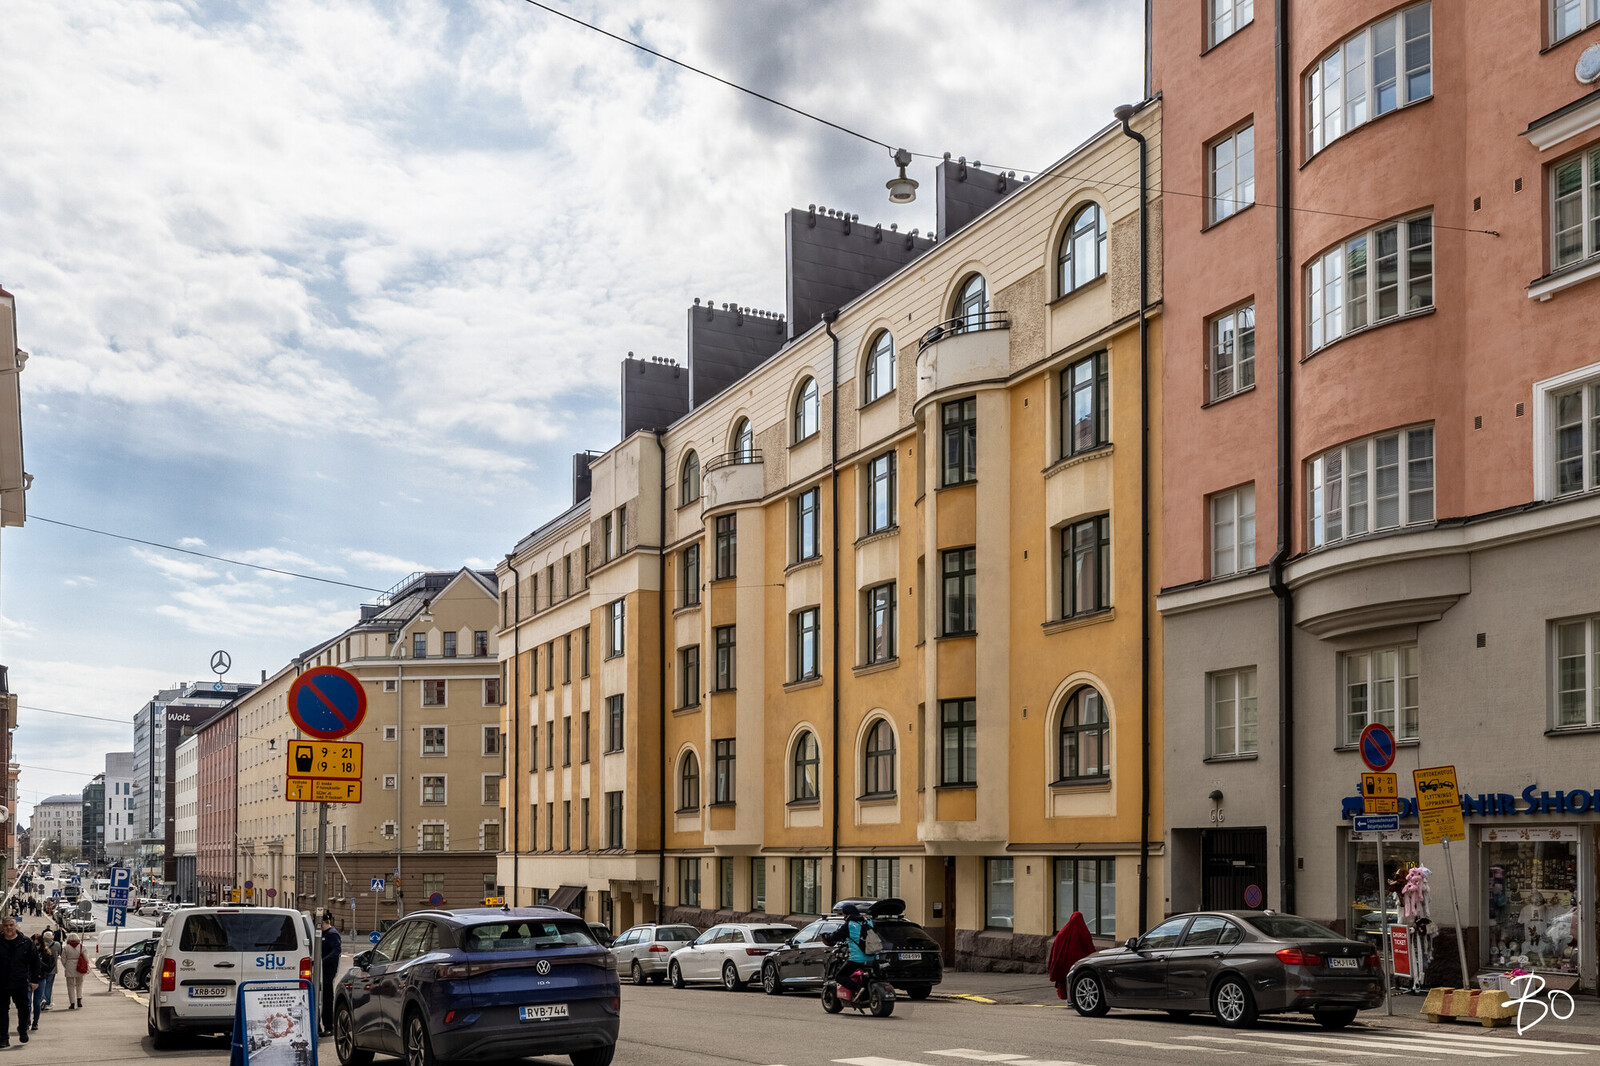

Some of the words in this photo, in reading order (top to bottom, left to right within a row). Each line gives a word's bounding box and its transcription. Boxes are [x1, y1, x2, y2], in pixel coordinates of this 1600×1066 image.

[168, 713, 191, 721] Wolt
[321, 747, 328, 758] 9
[341, 748, 353, 758] 21
[1416, 768, 1453, 779] SIIRTOKEHOTUS
[298, 789, 302, 799] 1
[347, 785, 356, 798] F
[1424, 792, 1454, 800] FLYTTNINGS-
[1391, 801, 1396, 810] F
[1522, 784, 1600, 816] SHO
[1210, 808, 1225, 822] 66
[114, 869, 128, 887] P
[1394, 938, 1406, 946] TICKET
[256, 953, 286, 970] SHU
[194, 986, 226, 996] XRB-509
[527, 1005, 566, 1018] RVB-744
